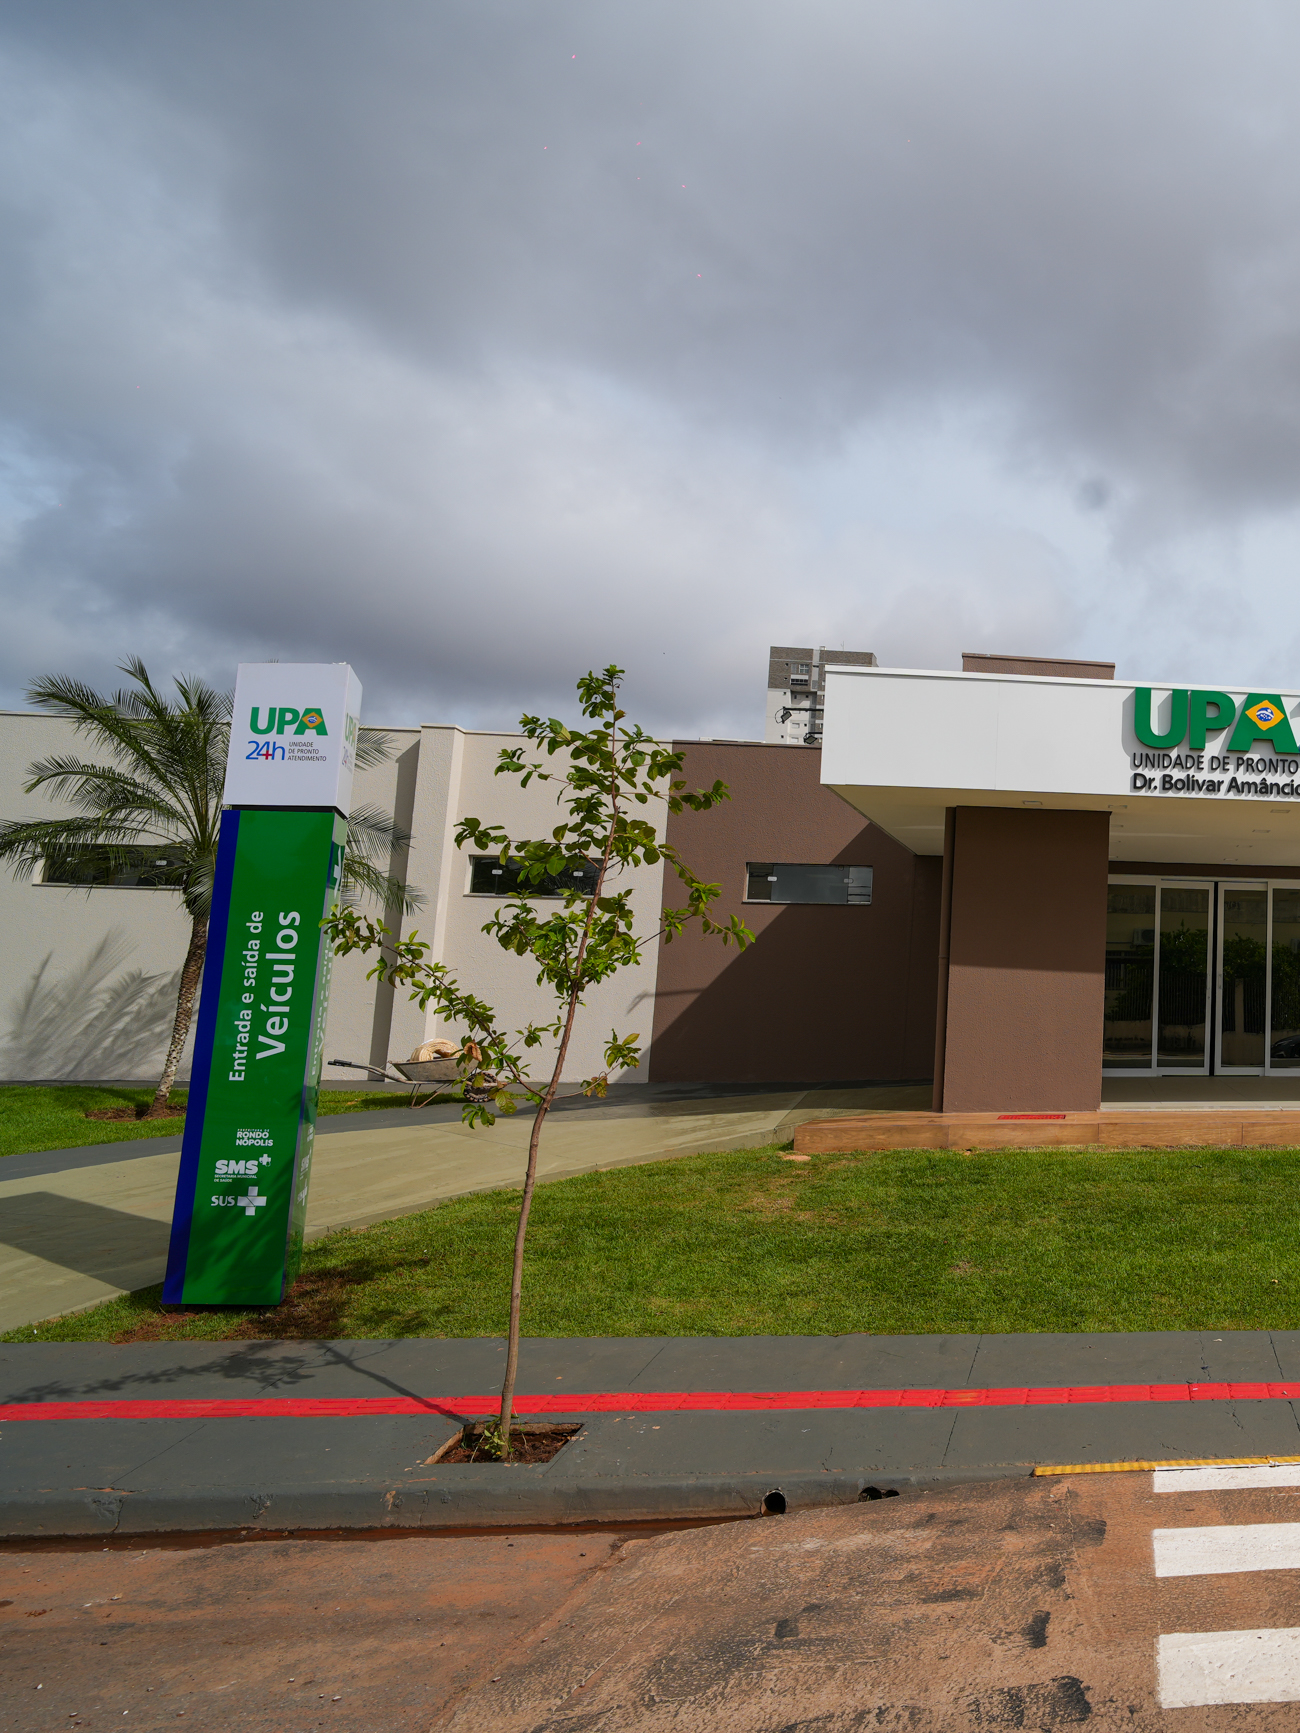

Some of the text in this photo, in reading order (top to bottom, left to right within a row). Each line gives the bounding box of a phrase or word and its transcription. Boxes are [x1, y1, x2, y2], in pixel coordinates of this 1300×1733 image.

[249, 706, 329, 736] UPA
[1134, 686, 1300, 755] UPA
[245, 740, 286, 761] 24h
[1132, 752, 1205, 771] UNIDADE
[1210, 755, 1230, 772] DE
[1236, 756, 1299, 776] PRONTO
[1132, 773, 1158, 792] Dr.
[1161, 774, 1223, 794] Bolivar
[229, 911, 264, 1081] Entrada e saída de
[256, 911, 301, 1060] Veículos
[214, 1159, 259, 1175] SMS
[210, 1195, 236, 1207] SUS
